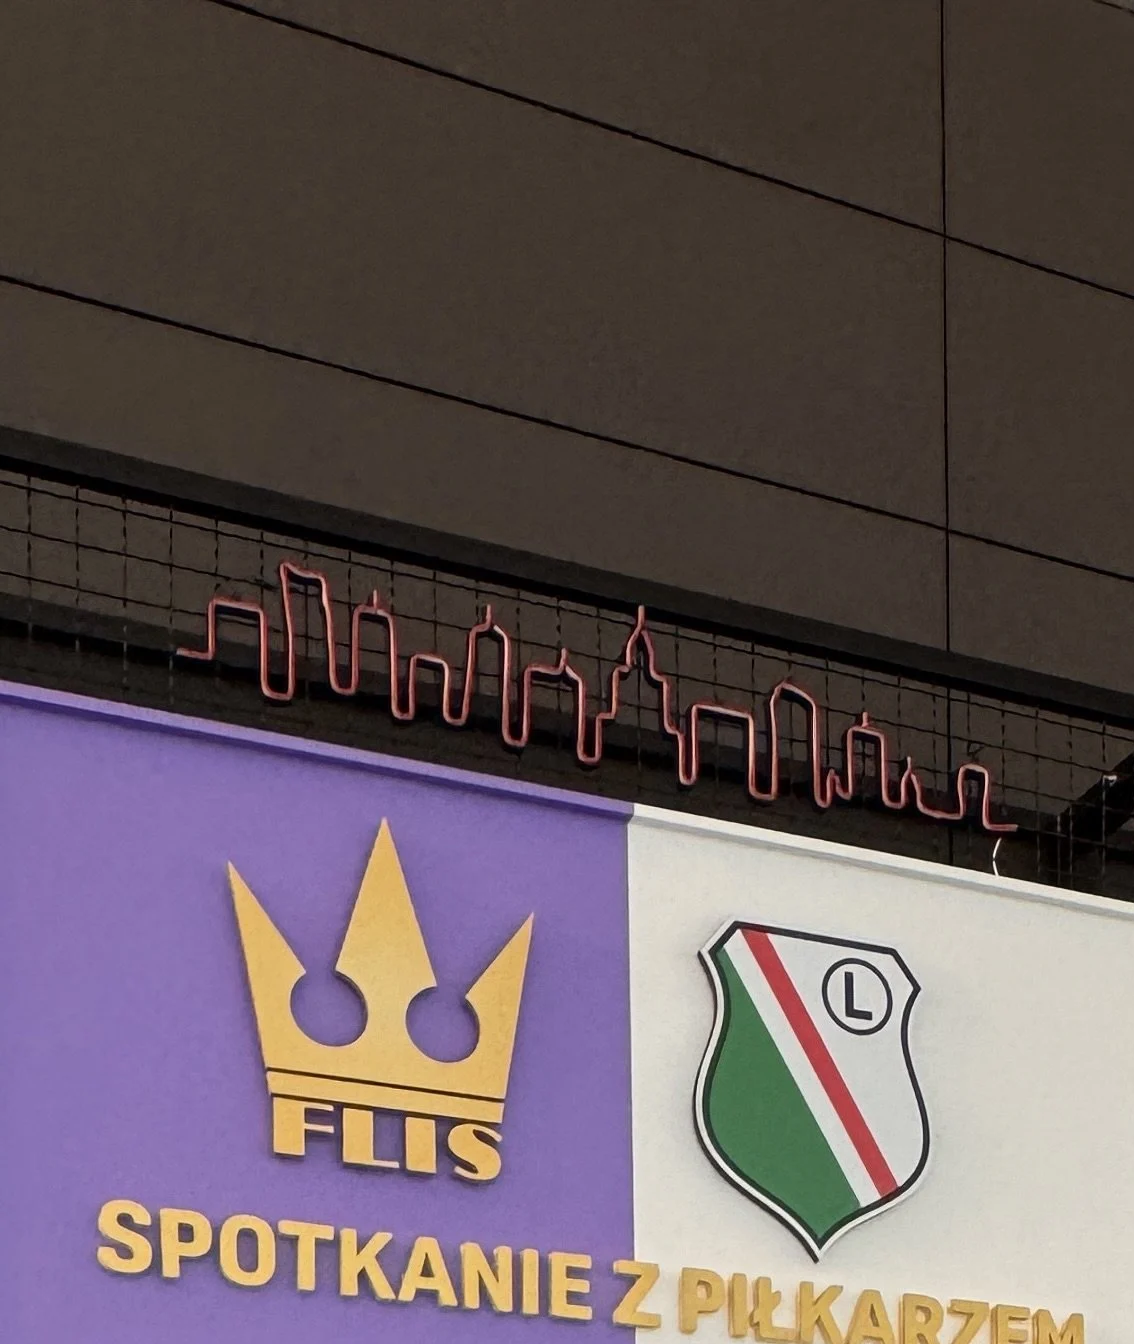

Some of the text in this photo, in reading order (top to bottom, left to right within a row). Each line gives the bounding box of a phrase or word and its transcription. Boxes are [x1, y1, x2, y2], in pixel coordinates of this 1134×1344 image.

[843, 970, 873, 1021] L
[271, 1097, 503, 1183] FLIS
[96, 1199, 594, 1322] SPOTKANIE
[611, 1259, 661, 1329] Z
